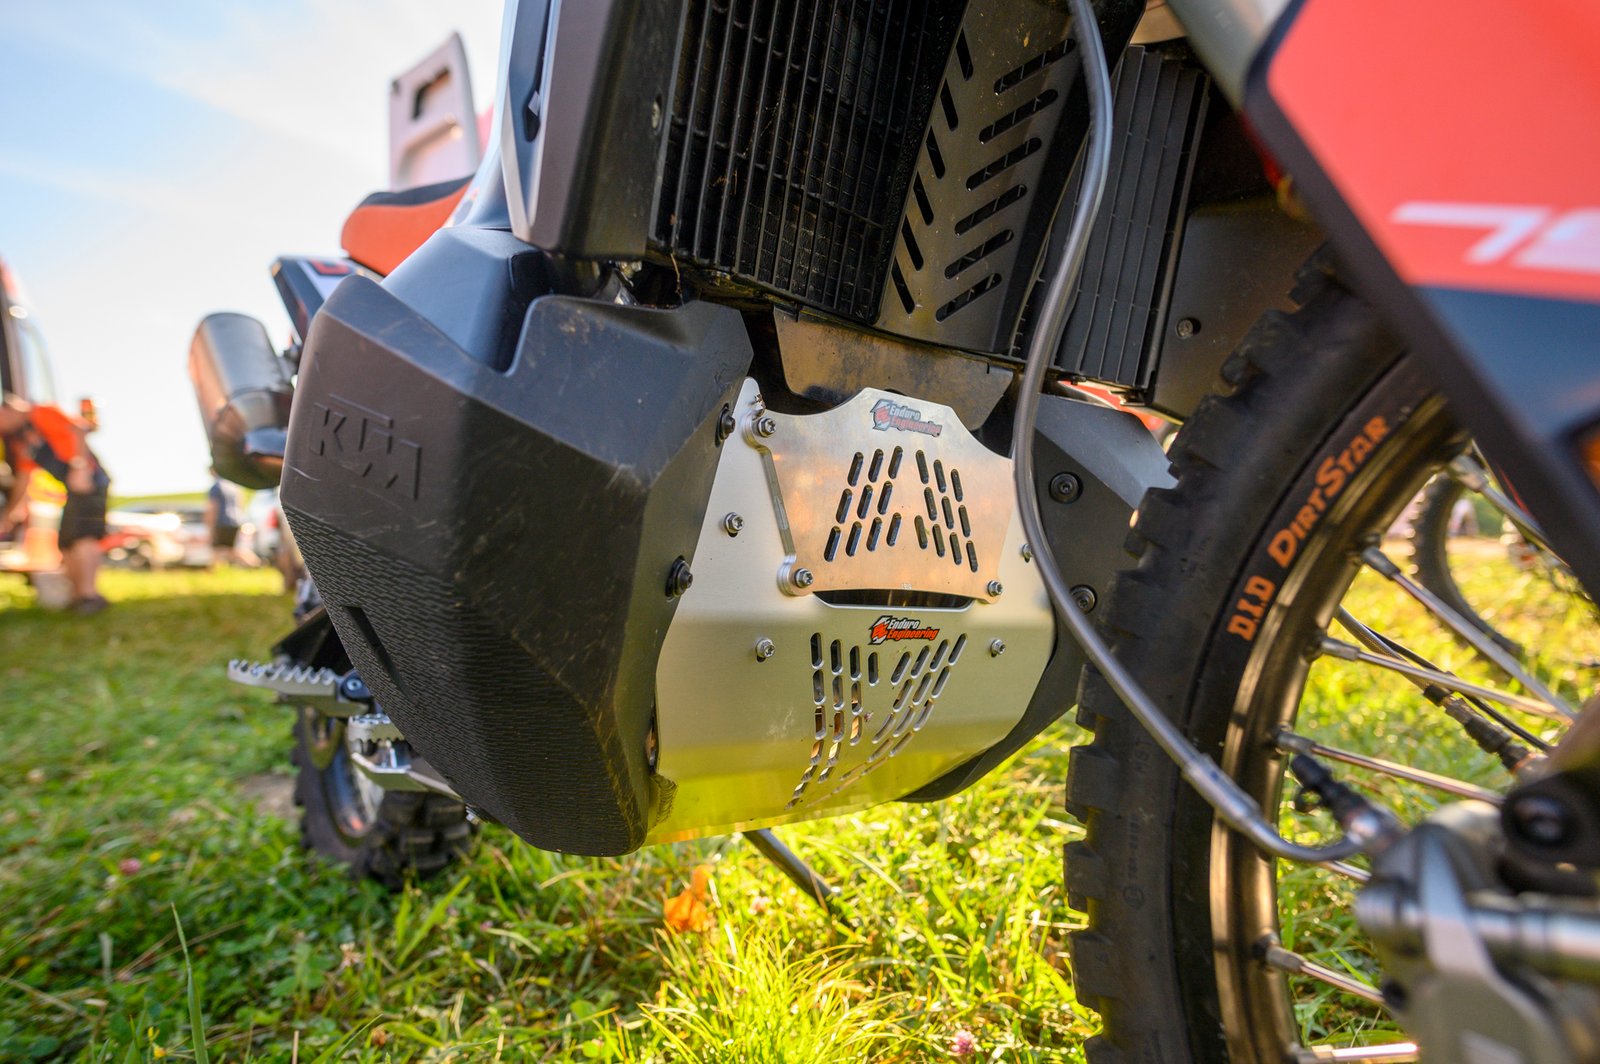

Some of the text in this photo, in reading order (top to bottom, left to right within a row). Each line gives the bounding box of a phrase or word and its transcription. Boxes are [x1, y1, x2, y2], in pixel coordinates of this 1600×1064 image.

[889, 404, 921, 420] Enduro
[310, 393, 423, 501] KTM
[888, 618, 920, 629] Enduro
[887, 627, 939, 641] Engineering
